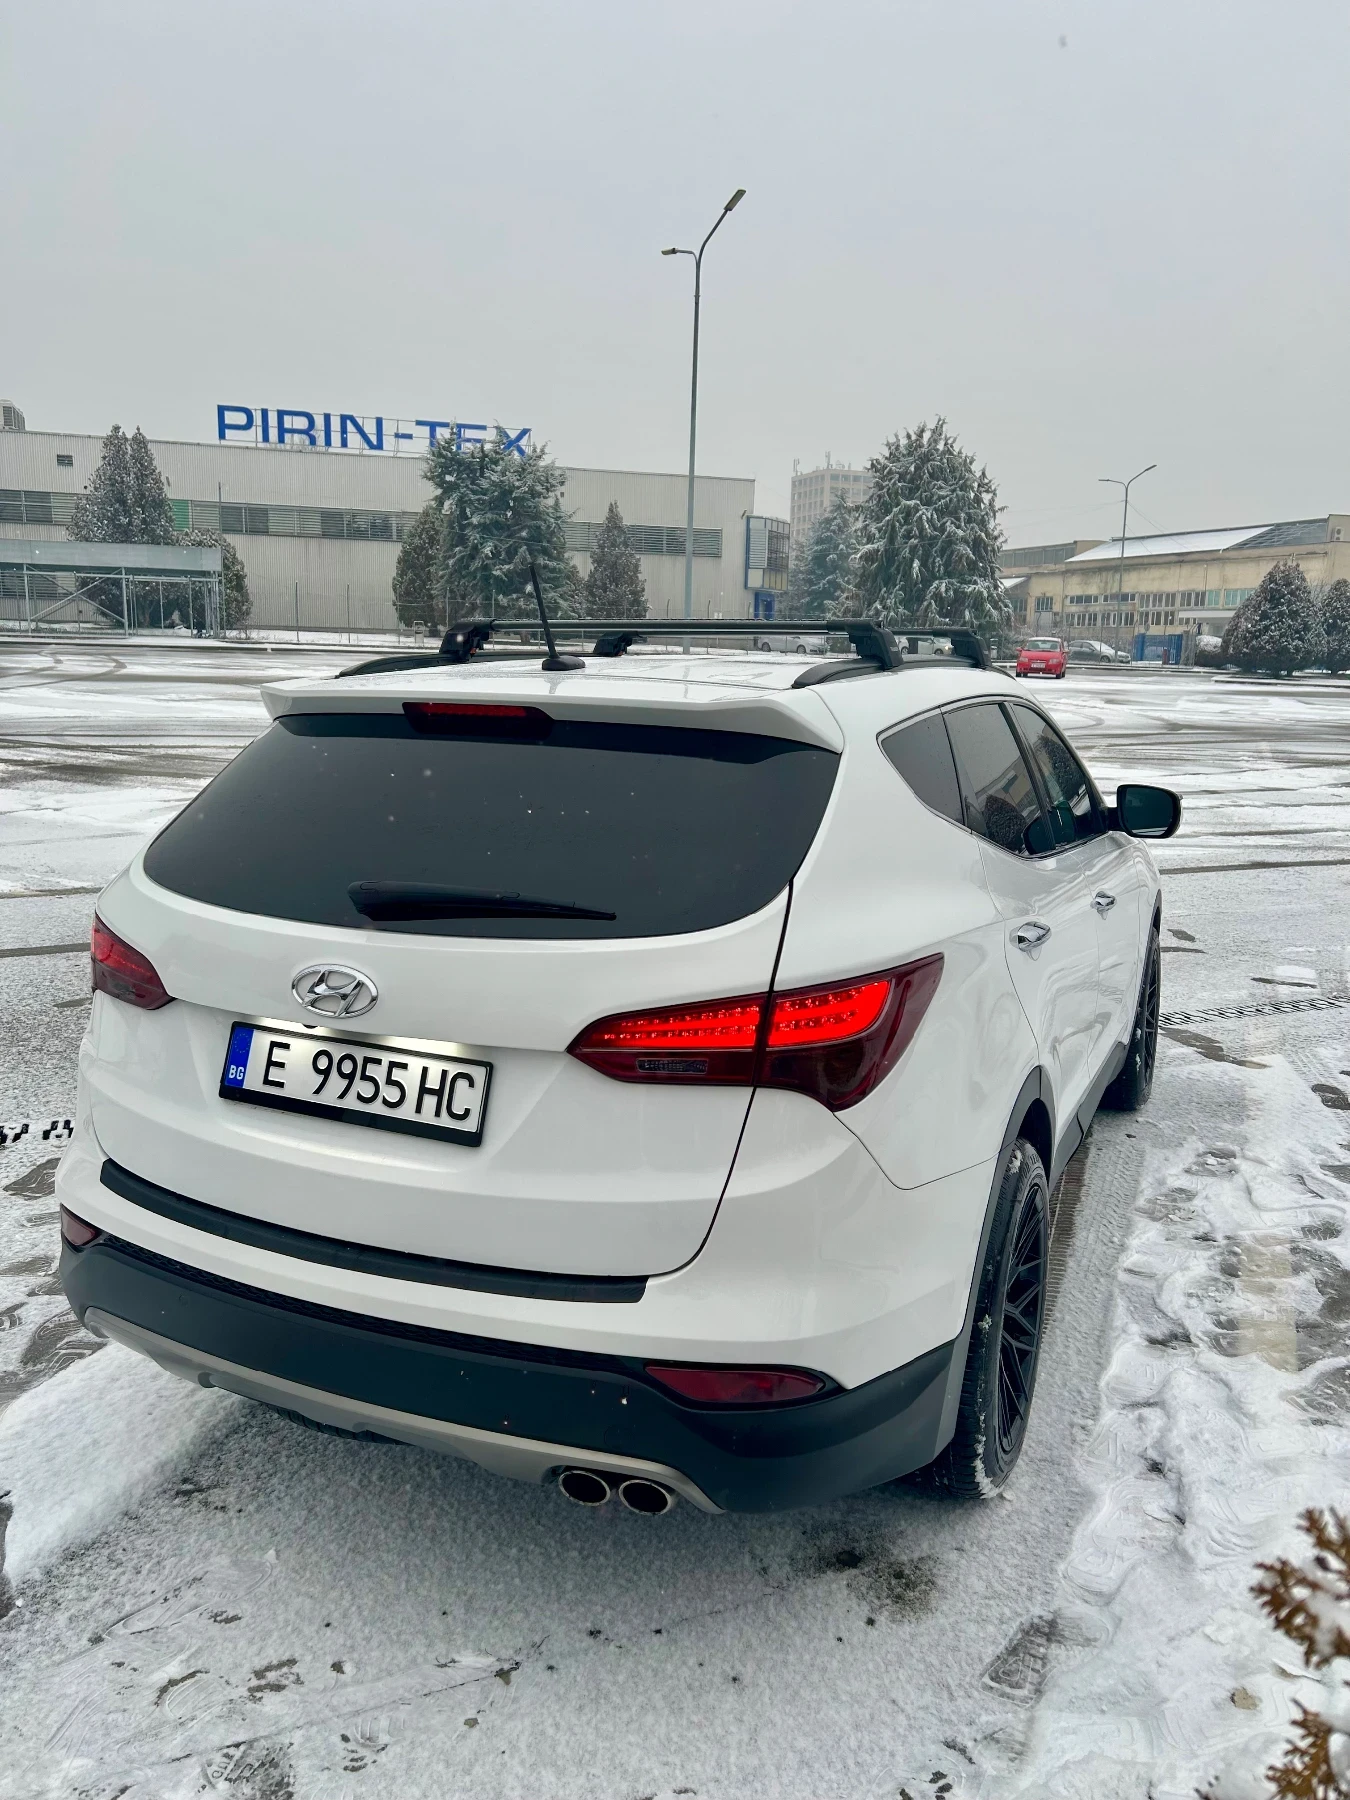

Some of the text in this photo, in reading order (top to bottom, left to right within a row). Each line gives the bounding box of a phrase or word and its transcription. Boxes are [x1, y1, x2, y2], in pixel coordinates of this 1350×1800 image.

[217, 404, 532, 458] PIRIN-TEX
[229, 1065, 245, 1080] BG
[263, 1040, 291, 1089] E
